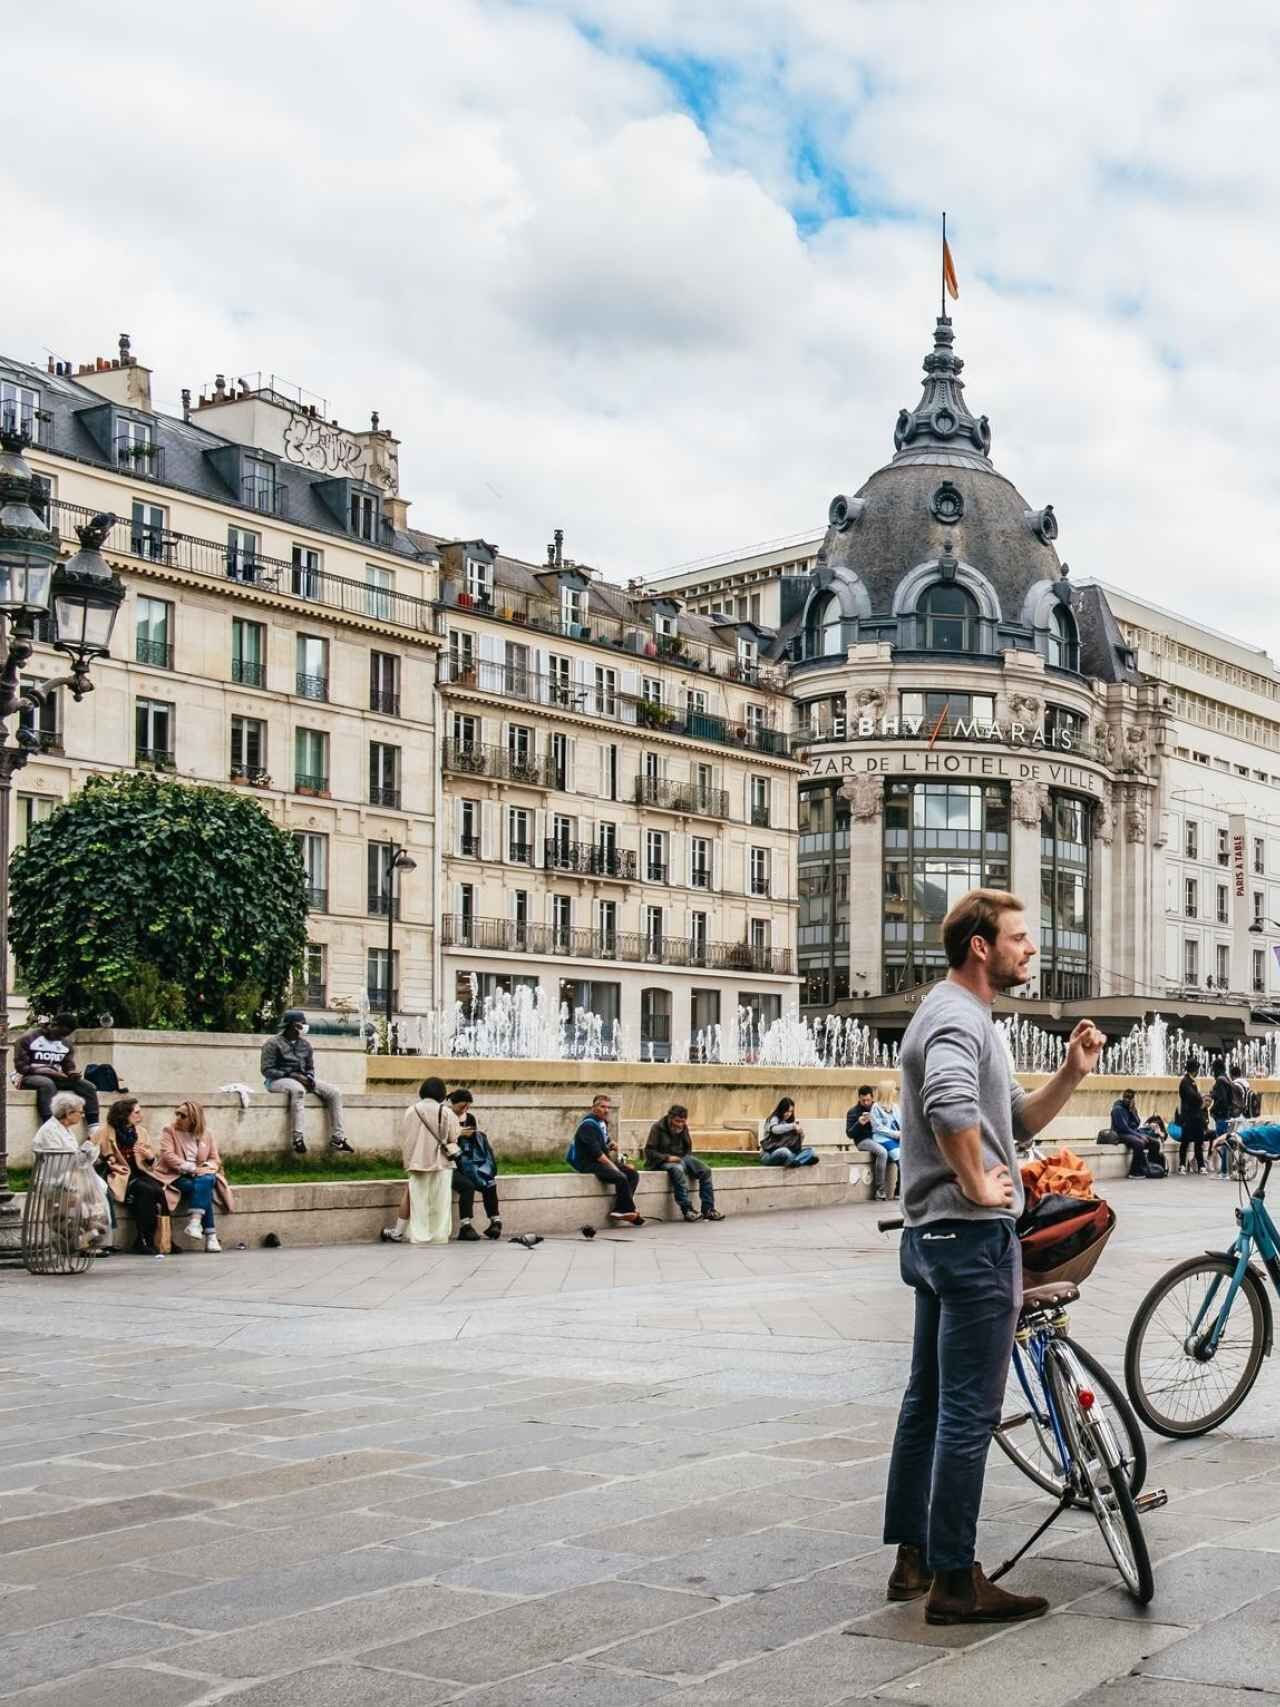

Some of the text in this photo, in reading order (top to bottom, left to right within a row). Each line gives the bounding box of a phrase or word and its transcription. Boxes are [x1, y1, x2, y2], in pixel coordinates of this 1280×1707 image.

[814, 717, 845, 739] LE
[954, 717, 1073, 750] MARAIS
[866, 757, 889, 772] DE
[1020, 763, 1040, 779] DE
[1049, 764, 1095, 791] VILLE
[1233, 835, 1243, 862] TABLE
[1235, 872, 1245, 896] PARIS
